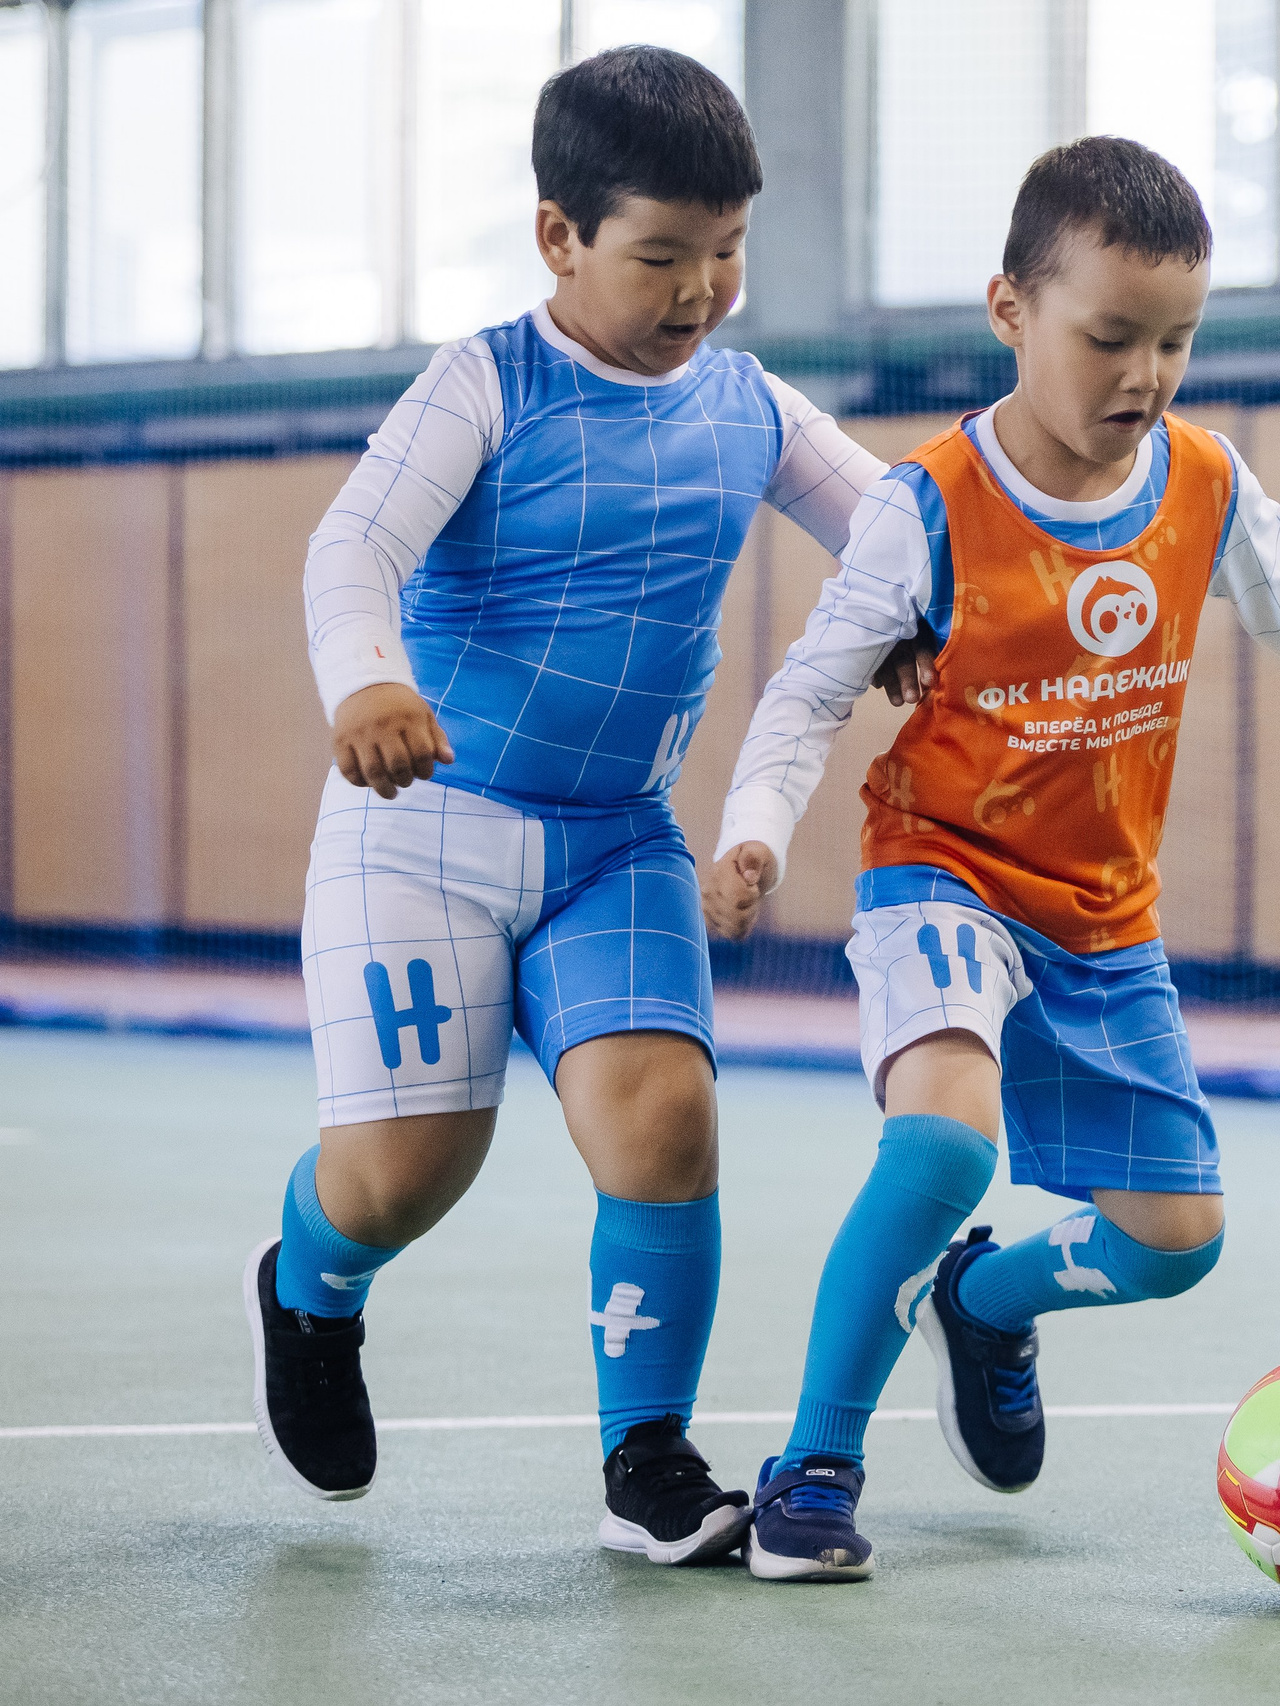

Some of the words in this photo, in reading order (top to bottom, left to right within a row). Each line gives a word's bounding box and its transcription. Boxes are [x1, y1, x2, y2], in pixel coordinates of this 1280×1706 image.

[977, 682, 1030, 710] ФК
[1007, 735, 1081, 753] ВМЕСТЕ
[1086, 735, 1113, 749] МЫ
[1115, 716, 1169, 743] СИЛЬНЕЕ!
[1024, 716, 1097, 735] ВПЕРЁД
[1102, 719, 1111, 731] К
[1113, 701, 1163, 727] ПОБЕДЕ!
